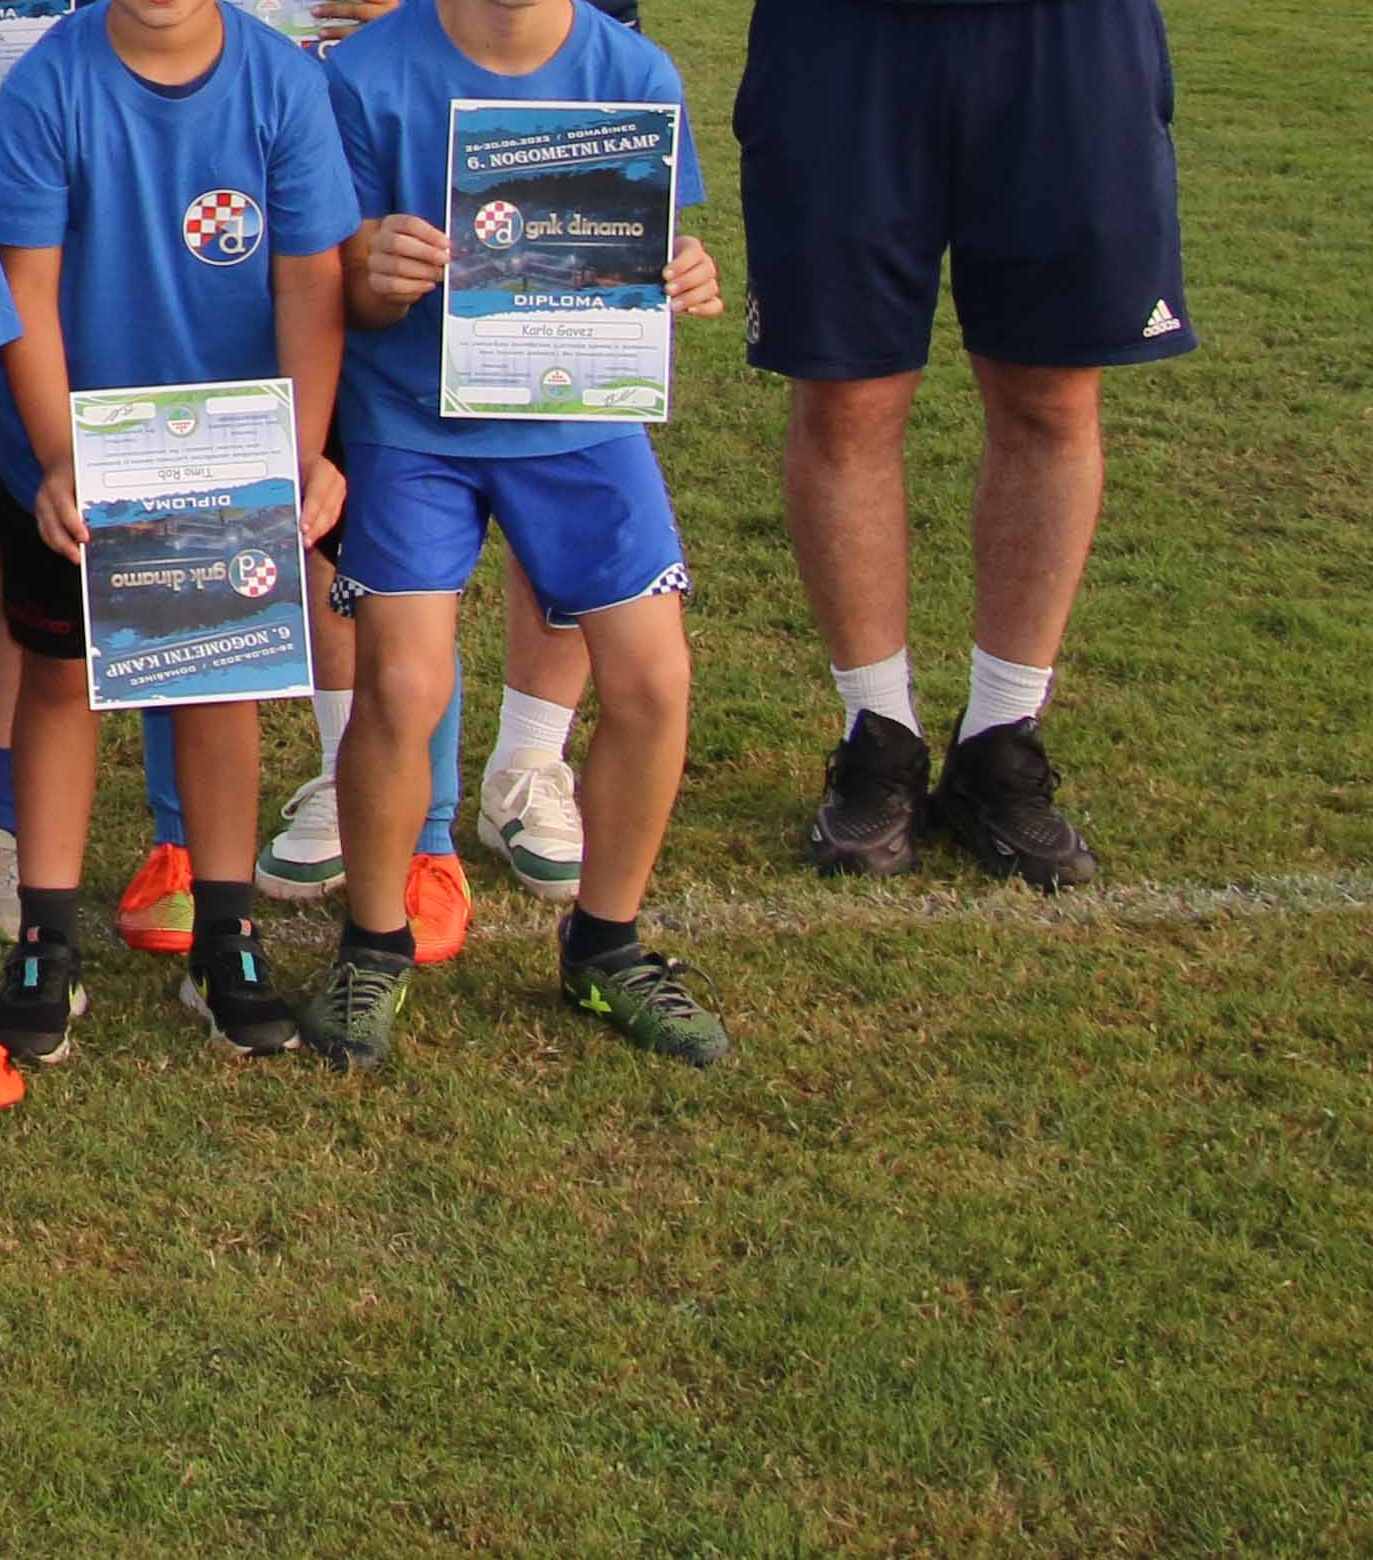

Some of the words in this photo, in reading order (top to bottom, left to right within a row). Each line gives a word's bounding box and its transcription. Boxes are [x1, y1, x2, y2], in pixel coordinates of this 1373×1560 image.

[468, 157, 485, 170] 6.
[490, 142, 599, 169] NOGOMETNI
[604, 134, 660, 152] KAMP
[526, 214, 563, 238] gnk
[567, 214, 644, 237] dinamo
[514, 294, 604, 307] DIPLOMA
[522, 324, 552, 337] Karlo
[143, 495, 230, 511] DIPLOMA
[111, 567, 186, 591] dinamo
[190, 562, 226, 589] gnk
[272, 626, 290, 640] 6.
[163, 630, 269, 665] NOGOMETNI
[106, 656, 160, 677] KAMP
